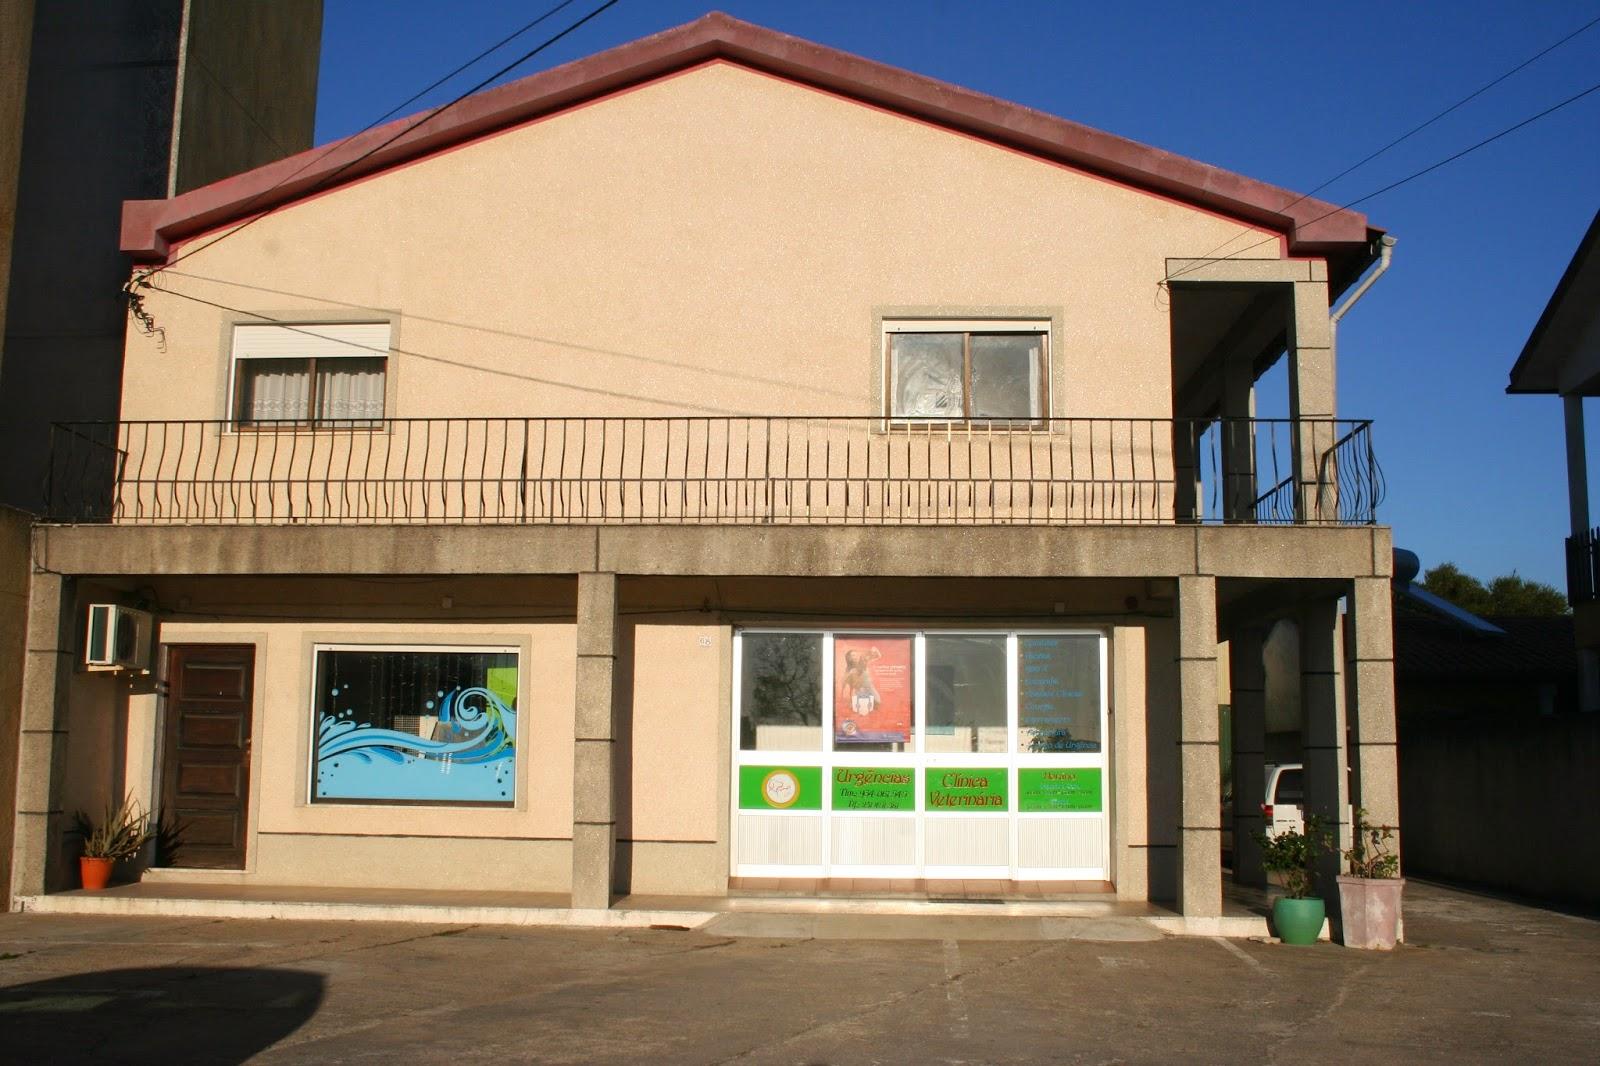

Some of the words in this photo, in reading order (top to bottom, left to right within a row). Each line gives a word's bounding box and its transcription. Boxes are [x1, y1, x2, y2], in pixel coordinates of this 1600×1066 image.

[837, 768, 912, 787] Urgências
[942, 772, 988, 788] Clínica
[930, 791, 1003, 807] Veterinária
